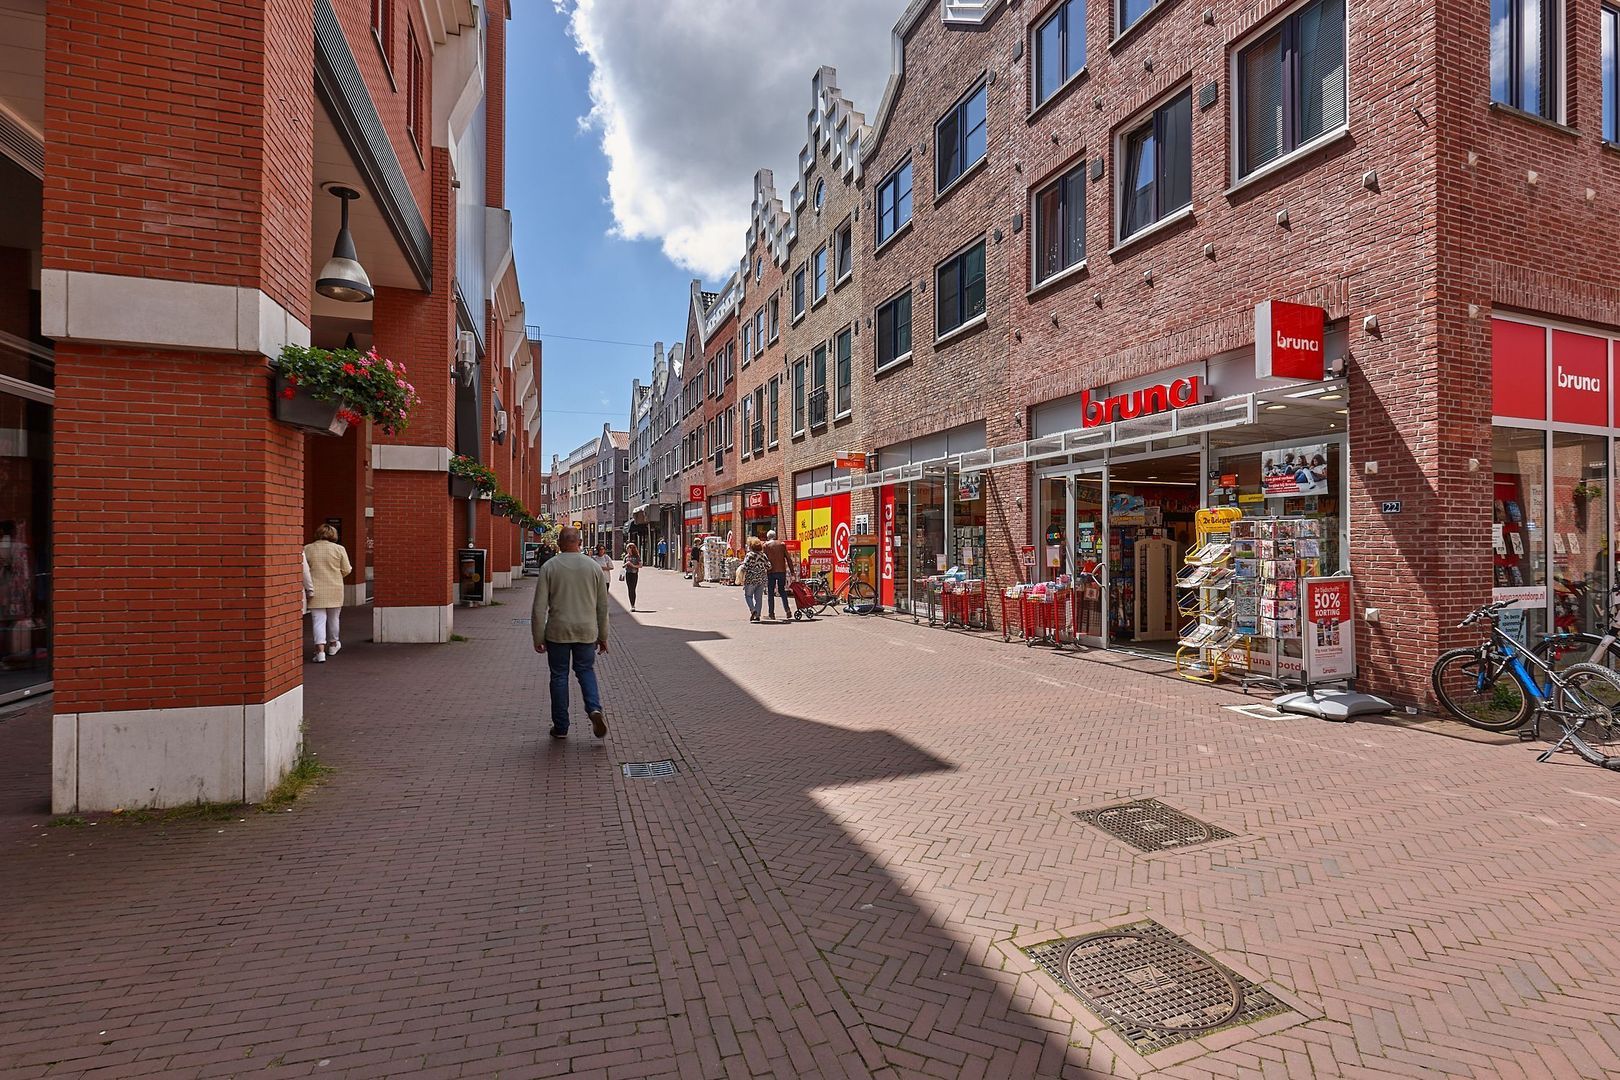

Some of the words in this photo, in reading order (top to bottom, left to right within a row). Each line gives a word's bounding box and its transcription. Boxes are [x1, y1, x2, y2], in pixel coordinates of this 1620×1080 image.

[1276, 330, 1319, 351] bruna
[1557, 365, 1601, 392] bruna
[1081, 375, 1199, 428] bruna
[1384, 502, 1398, 513] 22
[882, 504, 892, 580] bruna
[1314, 593, 1340, 608] 50%
[1315, 609, 1340, 617] KORTING
